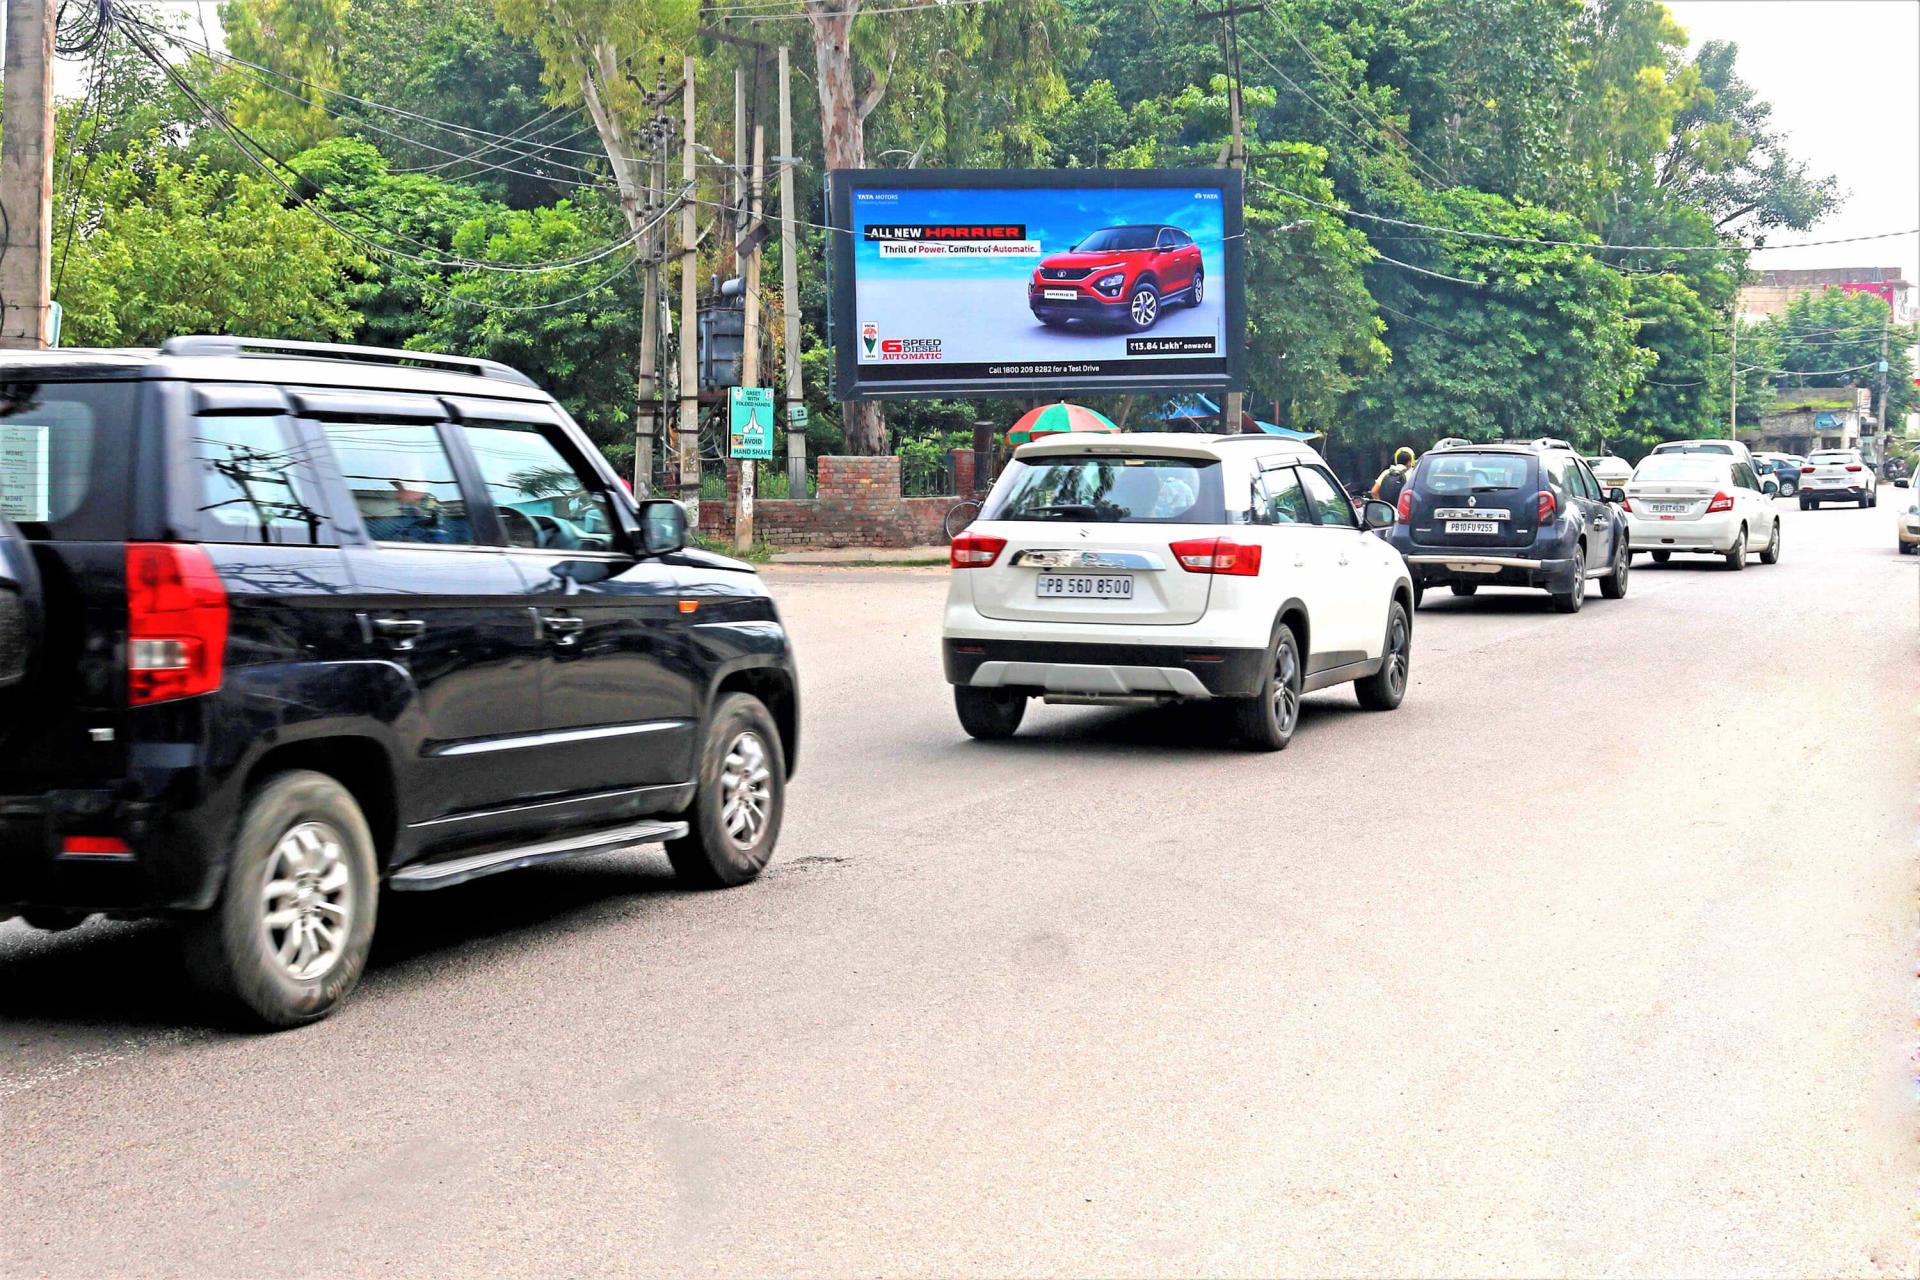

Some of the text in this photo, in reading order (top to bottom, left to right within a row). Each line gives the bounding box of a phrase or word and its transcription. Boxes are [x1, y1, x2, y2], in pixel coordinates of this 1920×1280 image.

[871, 227, 1019, 238] ALL NEW HARRIER
[884, 245, 906, 253] Thrill
[908, 245, 917, 253] of
[948, 245, 980, 253] Comfort
[983, 245, 992, 253] of
[881, 339, 902, 353] 6
[903, 345, 942, 353] DIESEL
[882, 353, 942, 361] AUTOMATIC
[988, 366, 1002, 374] Call
[1003, 366, 1019, 374] 1800
[1052, 365, 1062, 373] for
[1047, 578, 1130, 594] PB 56D 8500
